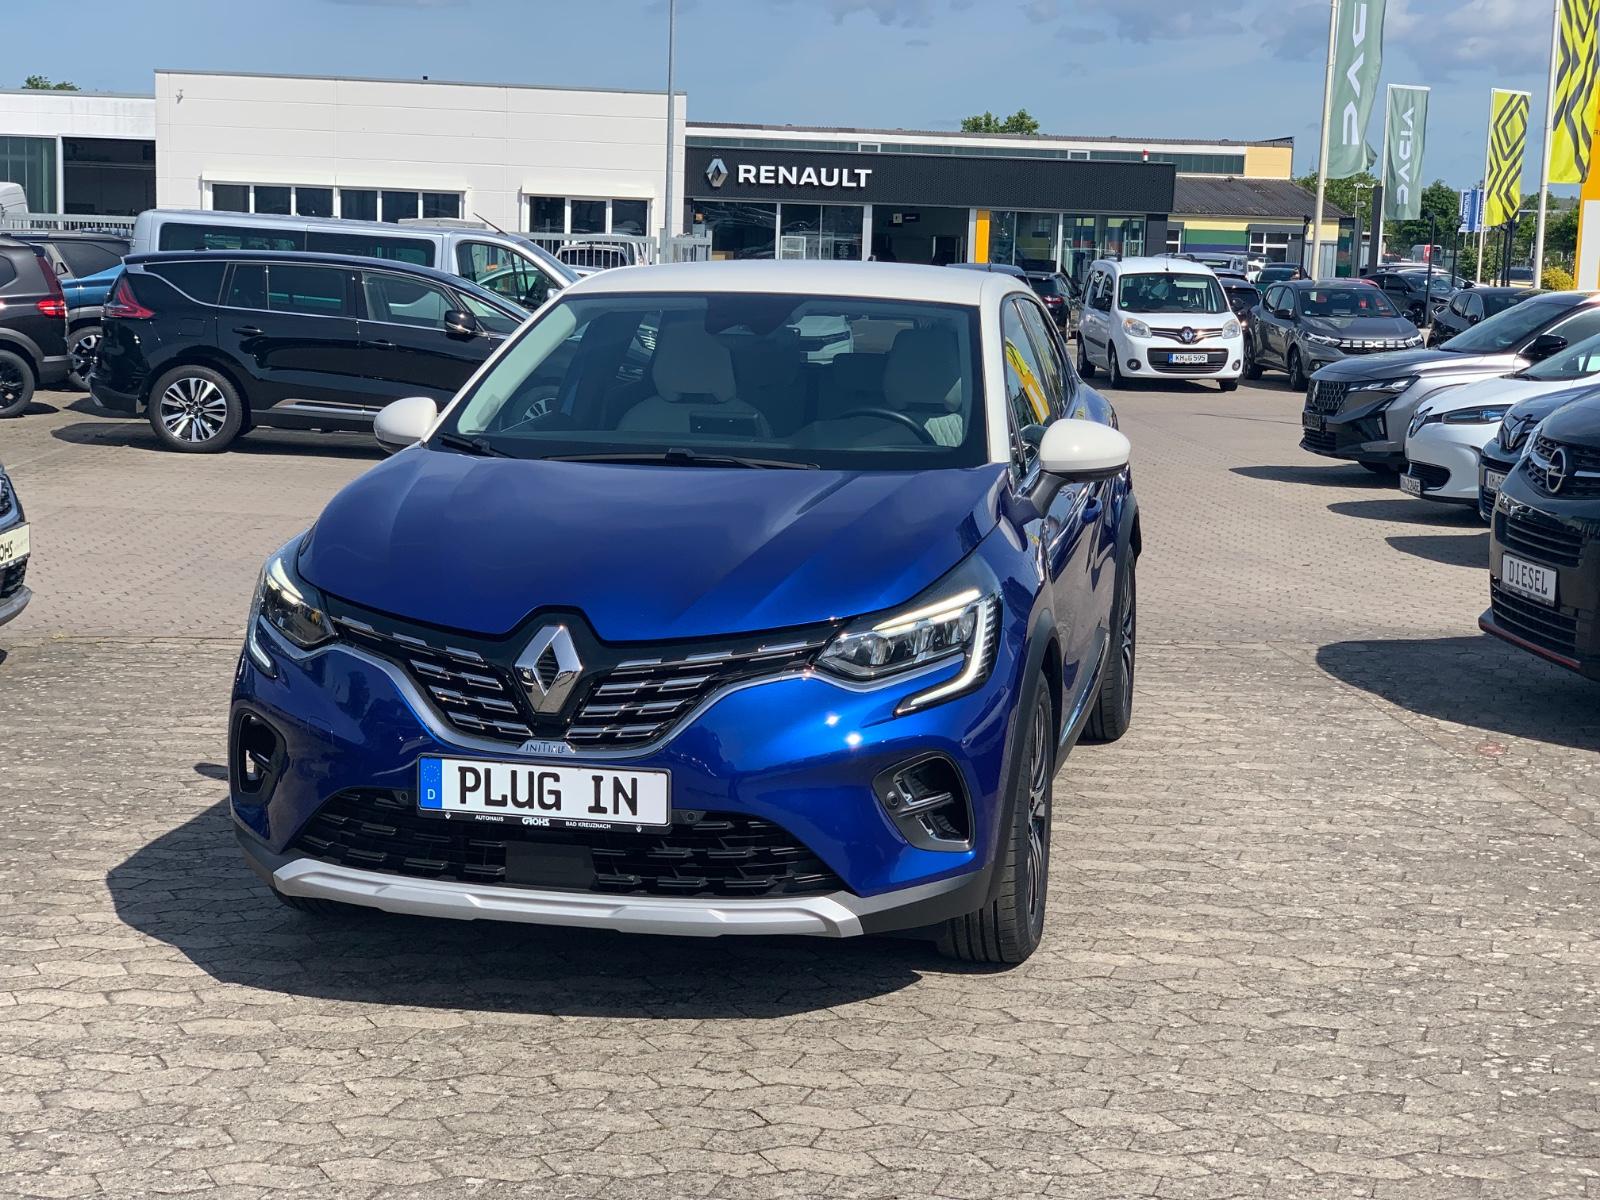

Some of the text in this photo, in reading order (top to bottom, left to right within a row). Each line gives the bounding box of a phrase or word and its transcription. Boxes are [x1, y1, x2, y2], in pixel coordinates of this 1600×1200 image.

[1396, 106, 1415, 205] DACIA
[738, 164, 872, 188] RENAULT
[1508, 560, 1548, 595] DIESEL
[427, 788, 436, 800] D
[457, 766, 638, 816] PLUG IN
[475, 814, 504, 822] AUTOHAUS
[521, 817, 550, 827] GROHS
